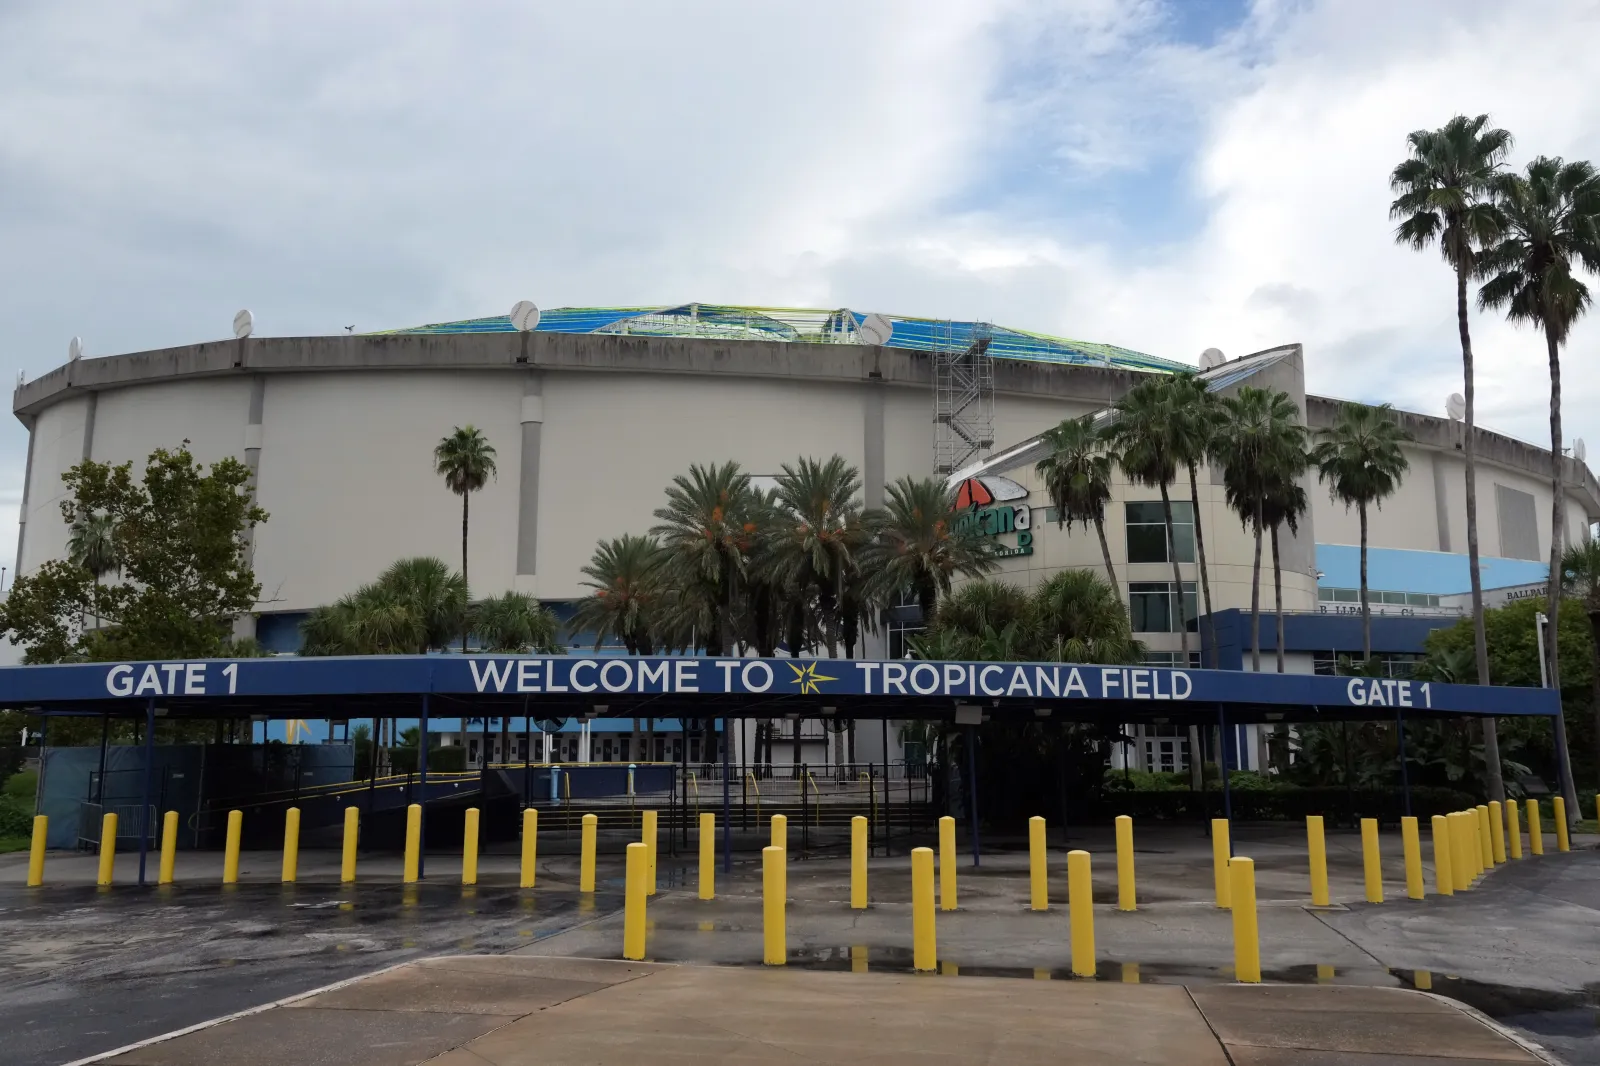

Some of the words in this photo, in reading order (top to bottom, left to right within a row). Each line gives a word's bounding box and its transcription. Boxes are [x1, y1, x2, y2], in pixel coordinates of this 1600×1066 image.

[1507, 588, 1548, 600] BALLPAR
[106, 663, 207, 697] GATE
[223, 663, 238, 695] 1
[469, 660, 699, 693] WELCOME
[716, 660, 774, 693] TO
[855, 662, 1089, 698] TROPICANA
[1101, 668, 1193, 700] FIELD
[1347, 678, 1413, 707] GATE
[1420, 682, 1431, 709] 1
